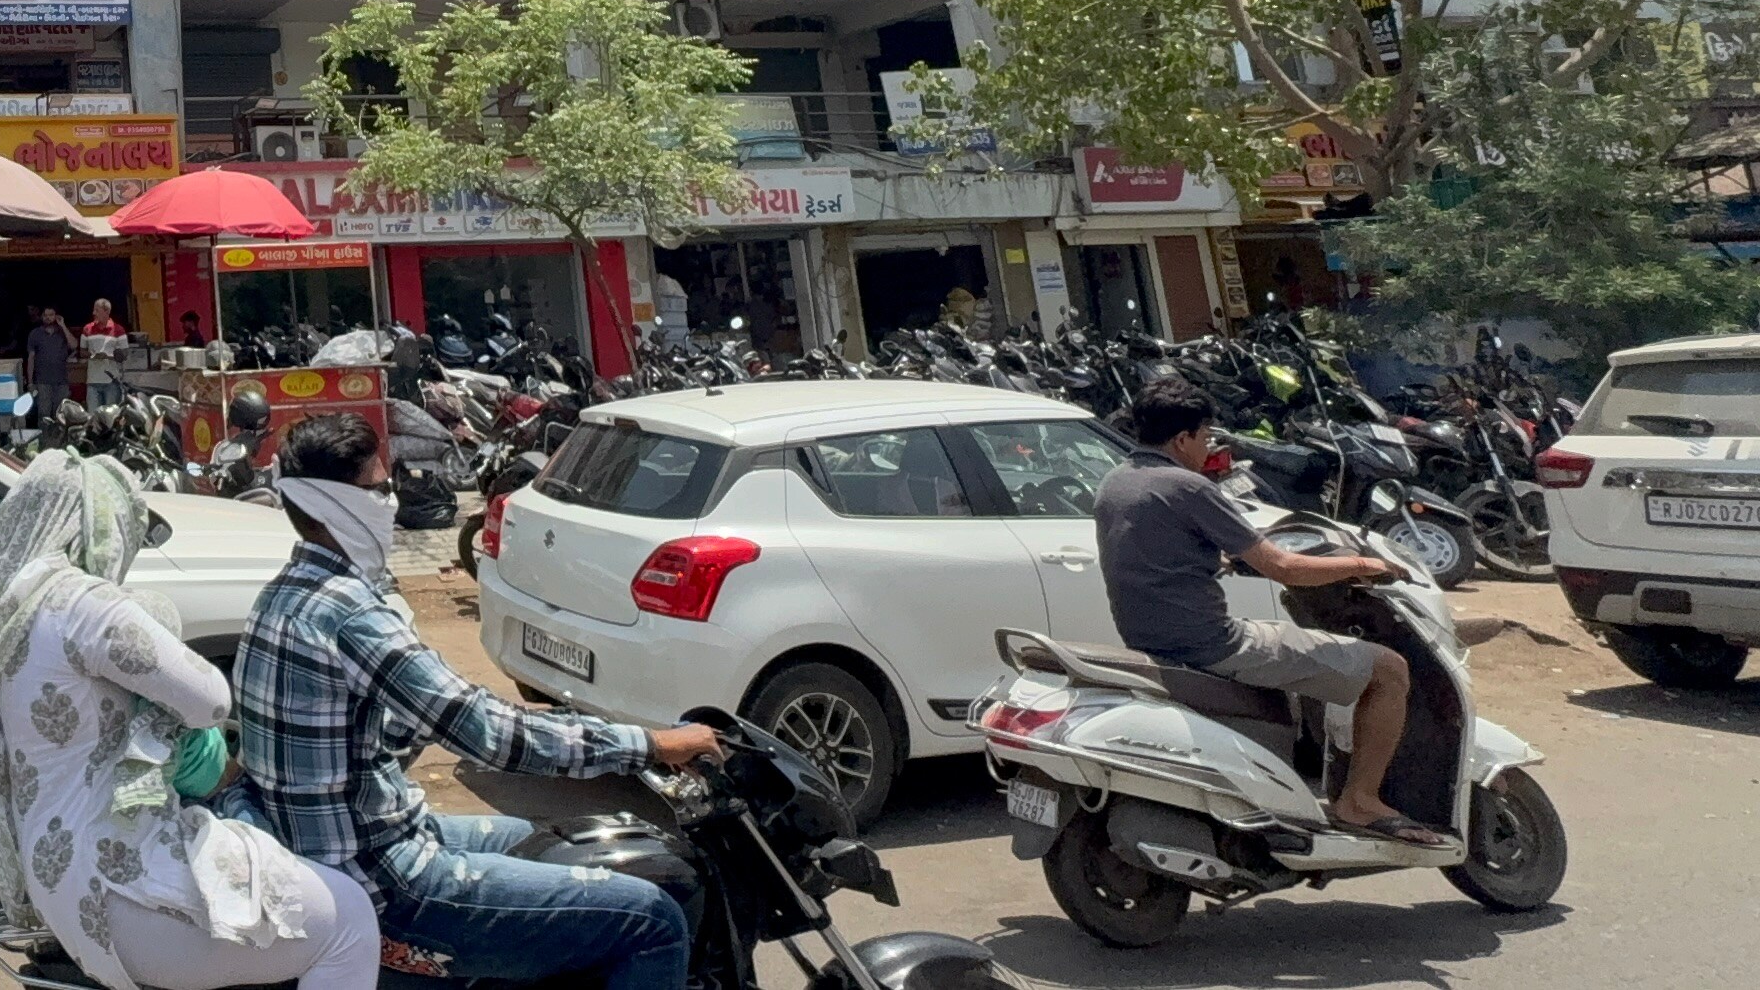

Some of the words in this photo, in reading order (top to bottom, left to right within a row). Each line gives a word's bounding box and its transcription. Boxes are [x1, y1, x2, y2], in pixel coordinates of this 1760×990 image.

[14, 129, 173, 172] ભોજનાલય
[805, 194, 843, 219] ટ્રેડર્સ
[385, 223, 411, 233] TVS
[258, 249, 297, 261] બાલાજી
